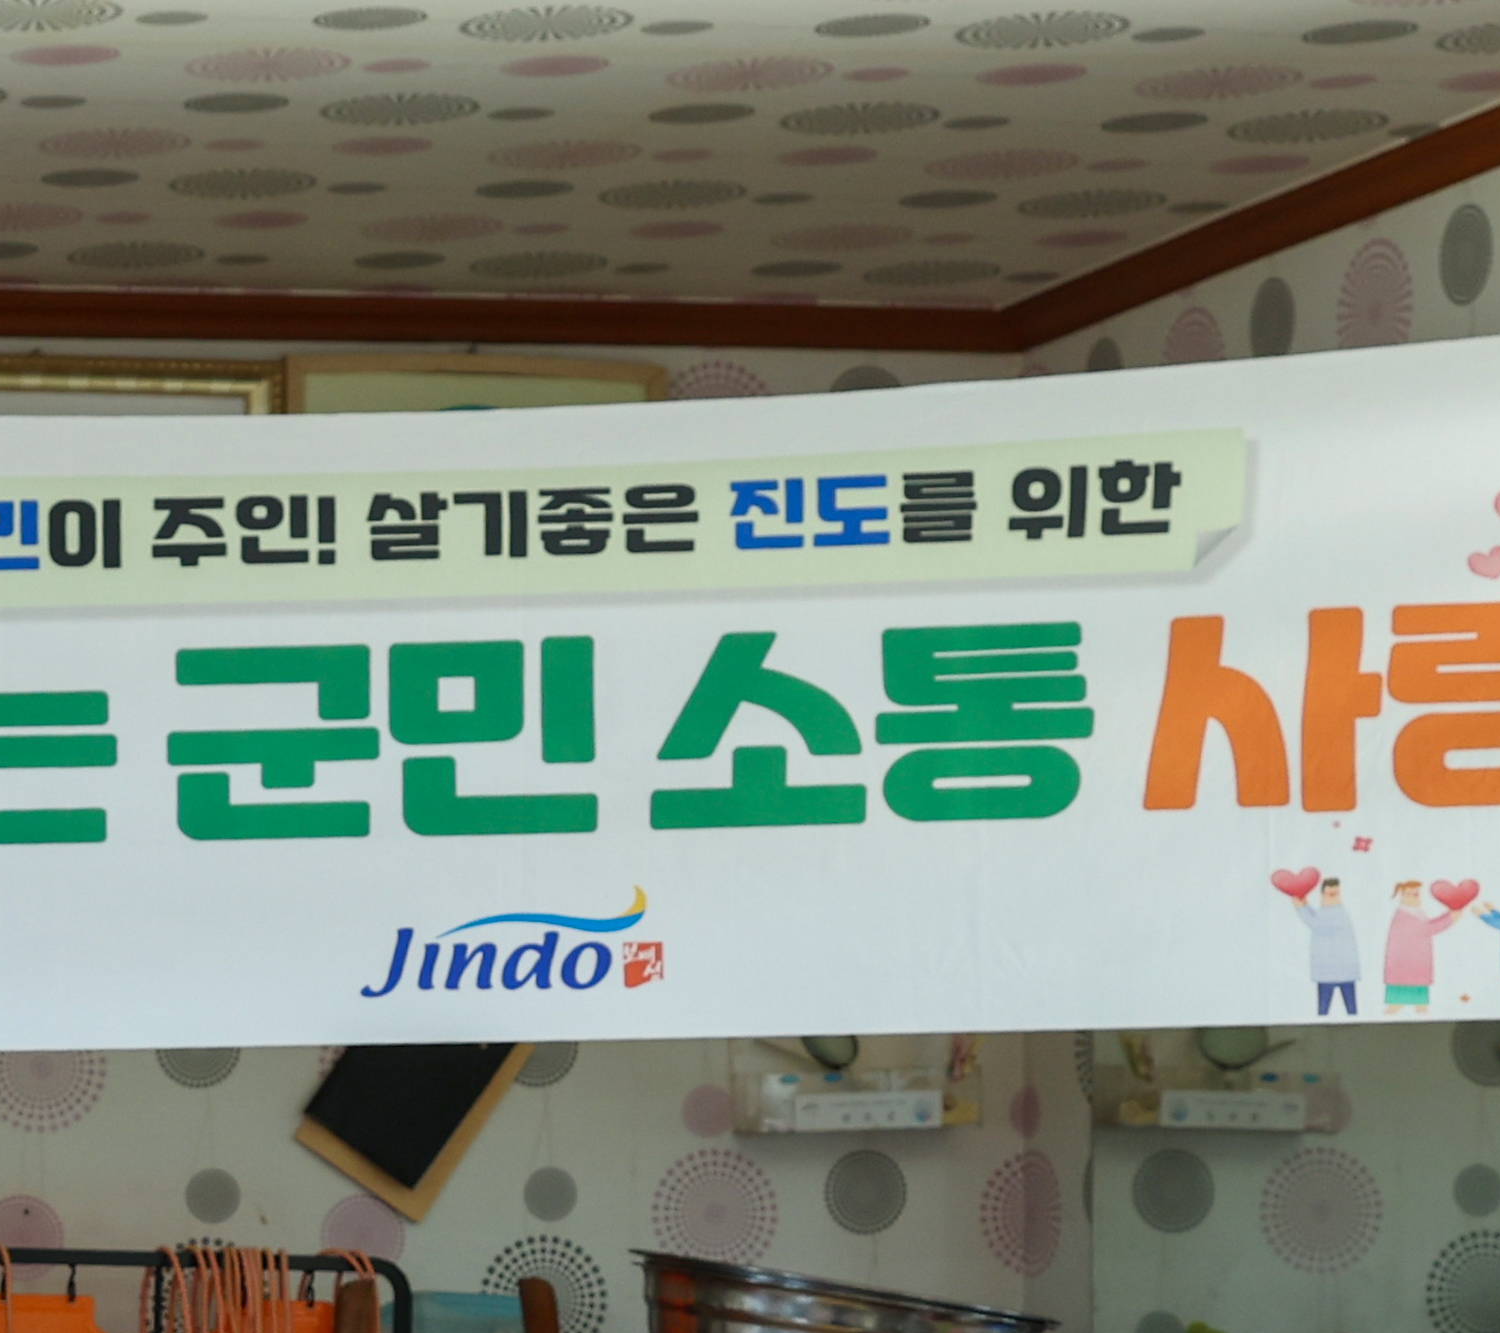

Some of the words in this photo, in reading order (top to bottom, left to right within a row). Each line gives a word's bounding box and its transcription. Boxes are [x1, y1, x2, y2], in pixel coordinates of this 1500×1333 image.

[152, 495, 337, 567] 주인!
[367, 484, 700, 561] 살기좋은
[730, 471, 977, 550] 진도를
[1008, 460, 1182, 539] 위한
[167, 635, 598, 841] 군민
[649, 621, 1095, 831] 소통
[360, 927, 613, 998] Jindo
